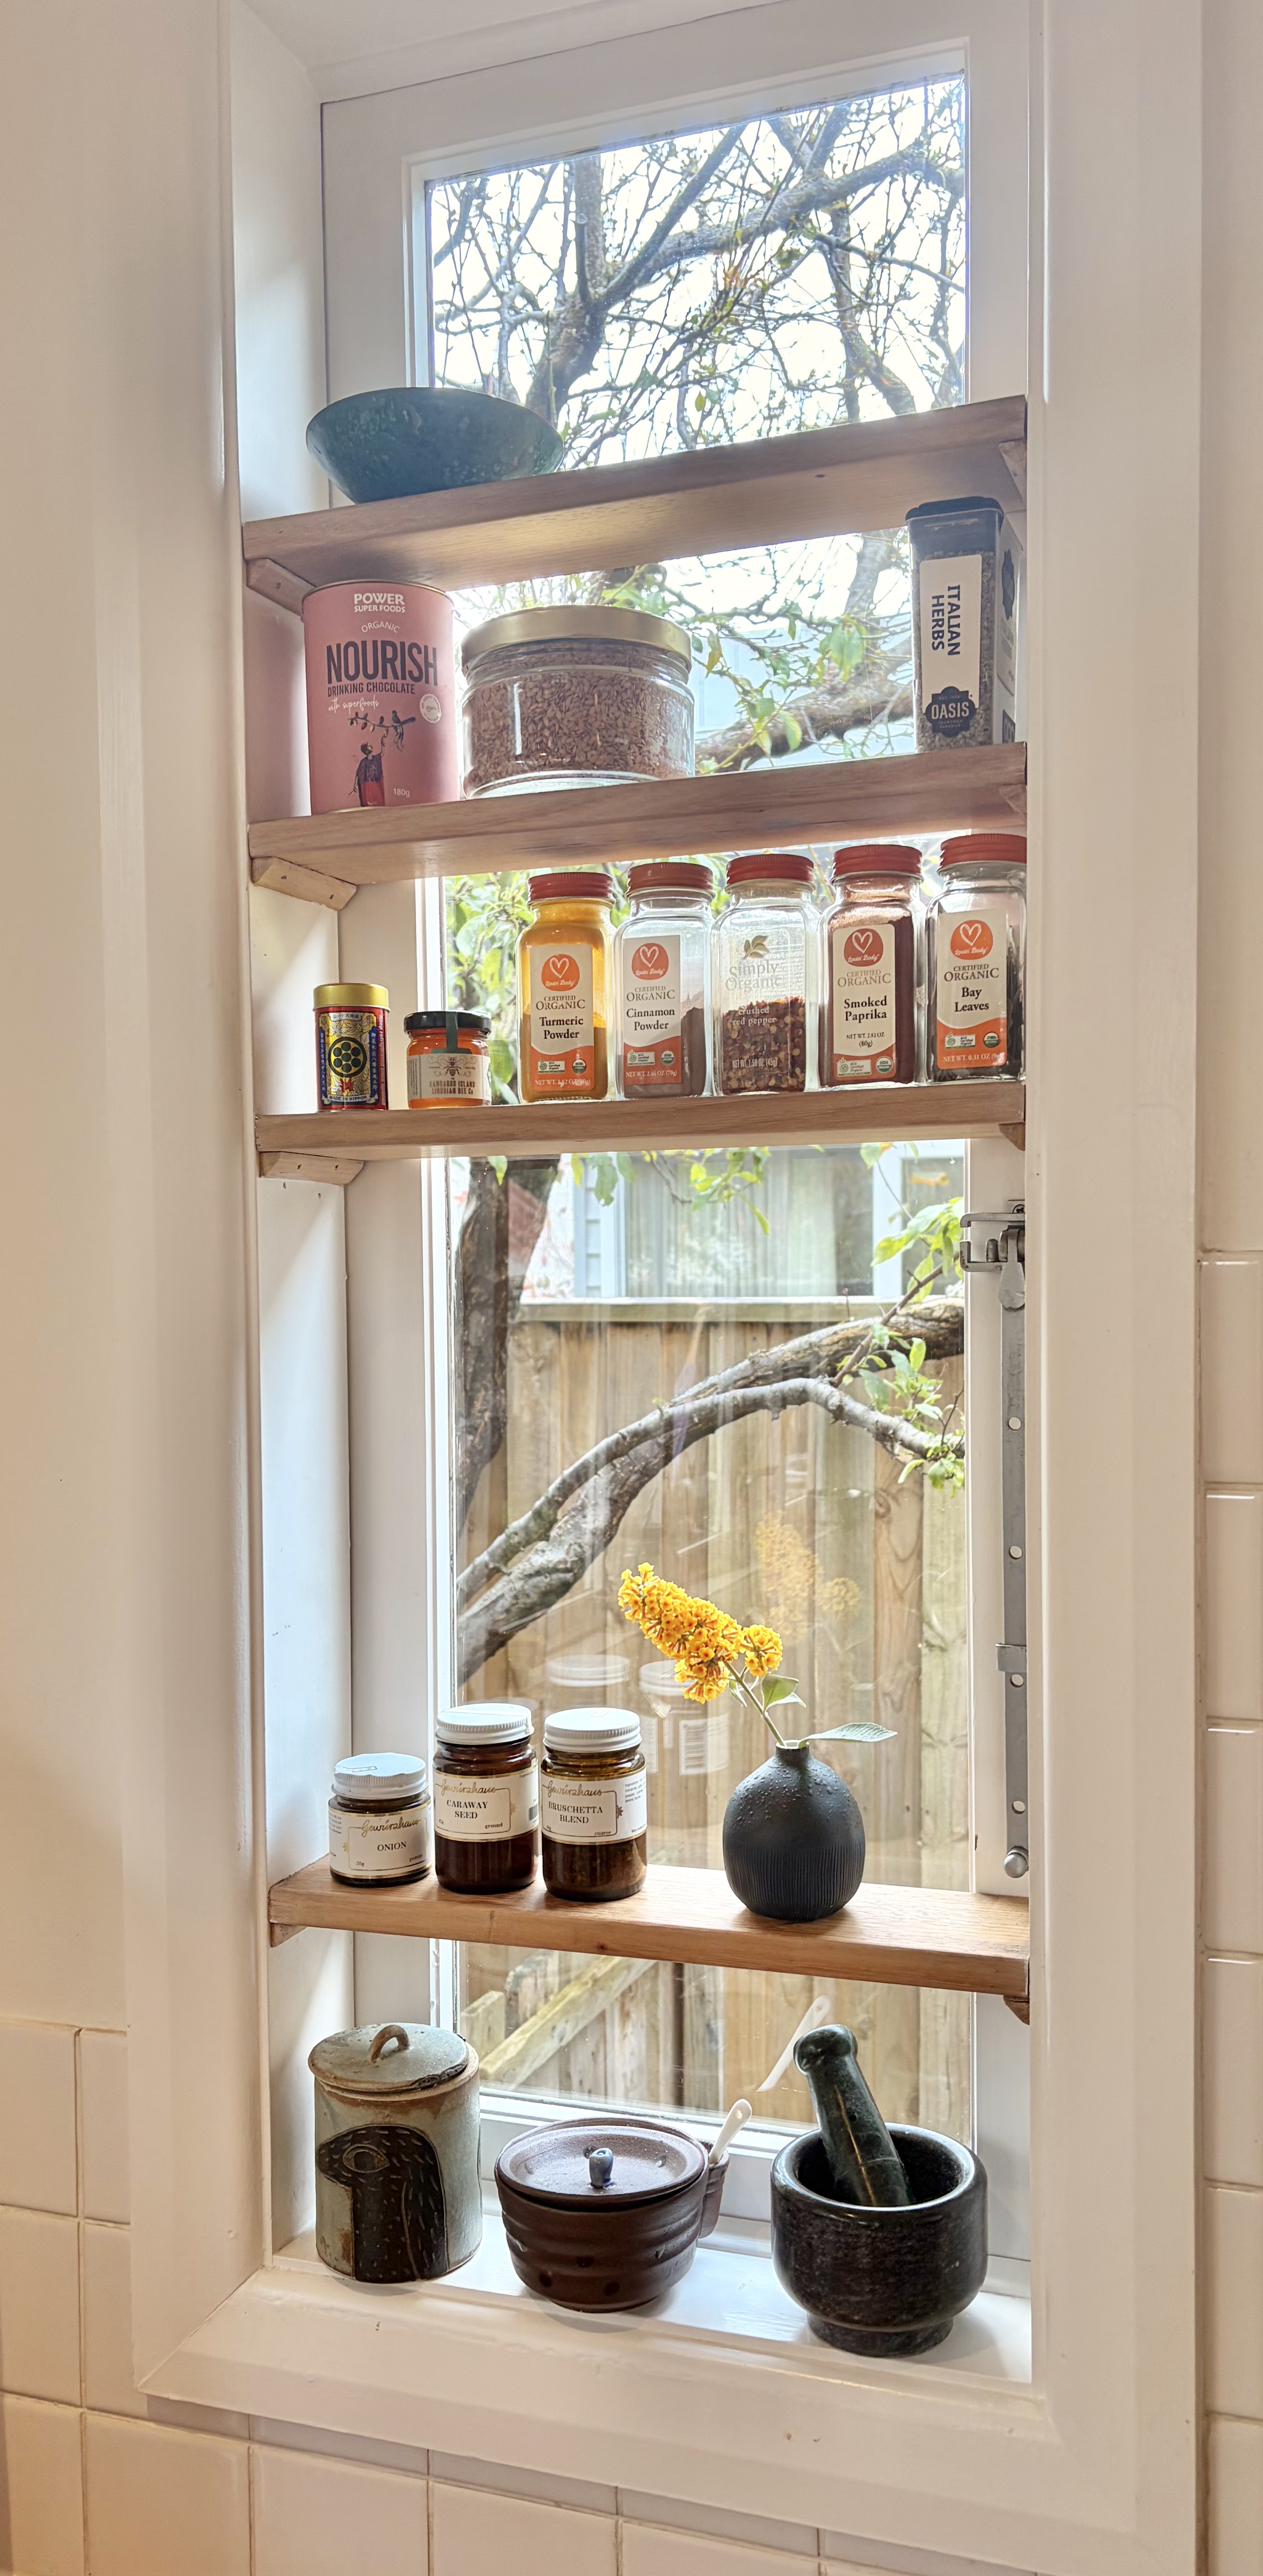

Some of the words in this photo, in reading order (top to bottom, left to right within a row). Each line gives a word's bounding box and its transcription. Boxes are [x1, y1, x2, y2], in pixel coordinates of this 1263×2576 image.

[354, 593, 405, 605] POWER
[379, 605, 405, 613] FOODS
[932, 595, 945, 650] HERBS
[948, 585, 960, 656] ITALIAN
[361, 621, 400, 633] ORGANIC
[327, 640, 438, 686] NOURISH
[328, 683, 363, 697] DRINKING
[367, 682, 415, 694] CHOCOLATE
[343, 695, 379, 715] superfoods
[931, 702, 969, 719] OASIS
[393, 788, 410, 798] 180g
[729, 959, 779, 982] Simply
[954, 964, 989, 972] CERTIFIED
[838, 973, 891, 987] ORGANIC
[944, 968, 1000, 982] ORGANIC
[726, 975, 783, 992] Organic
[627, 990, 675, 1002] ORGANIC
[962, 987, 982, 1000] Bay
[536, 999, 585, 1010] ORGANIC
[844, 995, 887, 1009] Smoked
[954, 1002, 989, 1012] Leaves
[627, 1008, 675, 1018] Cinnamon
[738, 1005, 770, 1015] crushed
[845, 1008, 887, 1023] Paprika
[539, 1016, 584, 1026] Turmeric
[634, 1019, 669, 1031] Powder
[733, 1017, 745, 1025] red
[748, 1018, 776, 1027] pepper
[544, 1028, 579, 1039] Powder
[758, 1058, 765, 1067] OZ
[447, 1800, 488, 1809] CARAWAY
[548, 1801, 603, 1813] BRUSCHETTA
[455, 1811, 477, 1819] SEED
[560, 1815, 589, 1824] BLEND
[377, 1841, 407, 1852] ONION
